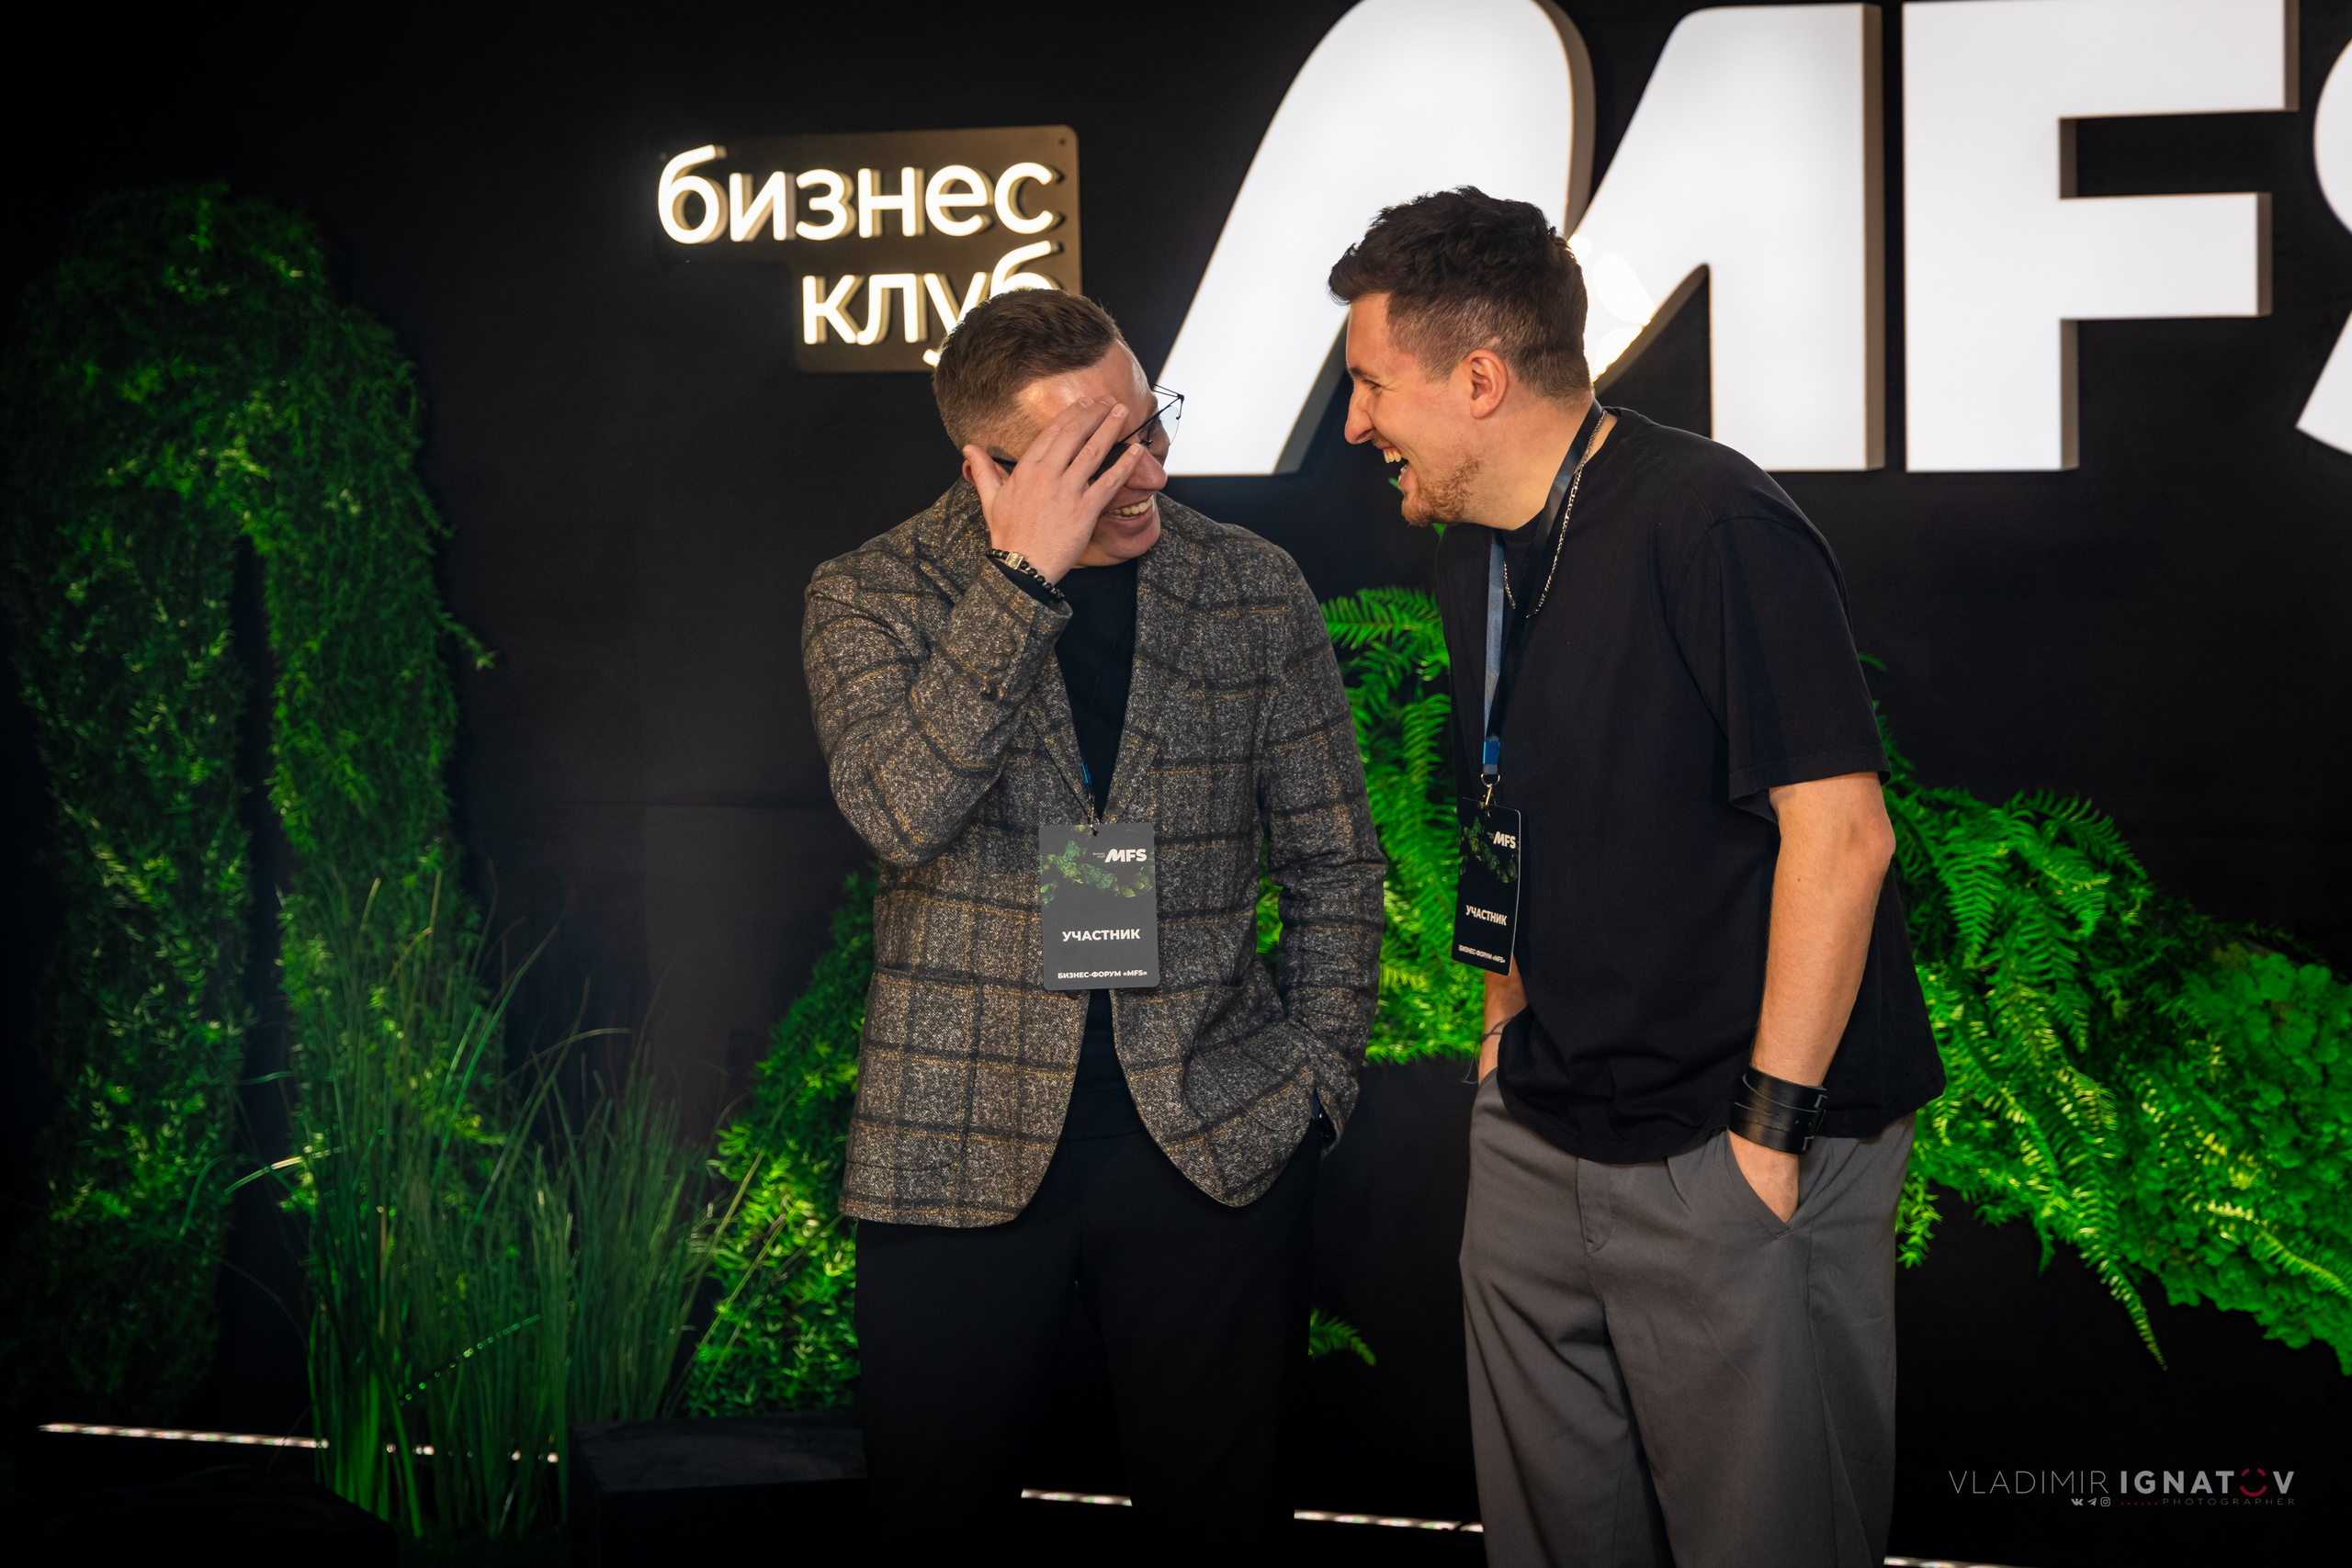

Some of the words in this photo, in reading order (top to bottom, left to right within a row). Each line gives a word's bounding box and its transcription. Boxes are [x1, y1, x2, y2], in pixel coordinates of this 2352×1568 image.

[657, 144, 1058, 245] бизнес
[1159, 0, 2352, 477] MF
[1493, 830, 1516, 849] MFS
[1104, 848, 1148, 863] MFS
[1465, 905, 1507, 926] УЧАСТНИК
[1062, 929, 1141, 942] УЧАСТНИК
[1057, 970, 1122, 979] БИЗНЕС-ФОРУМ
[1123, 969, 1148, 977] «MFS»
